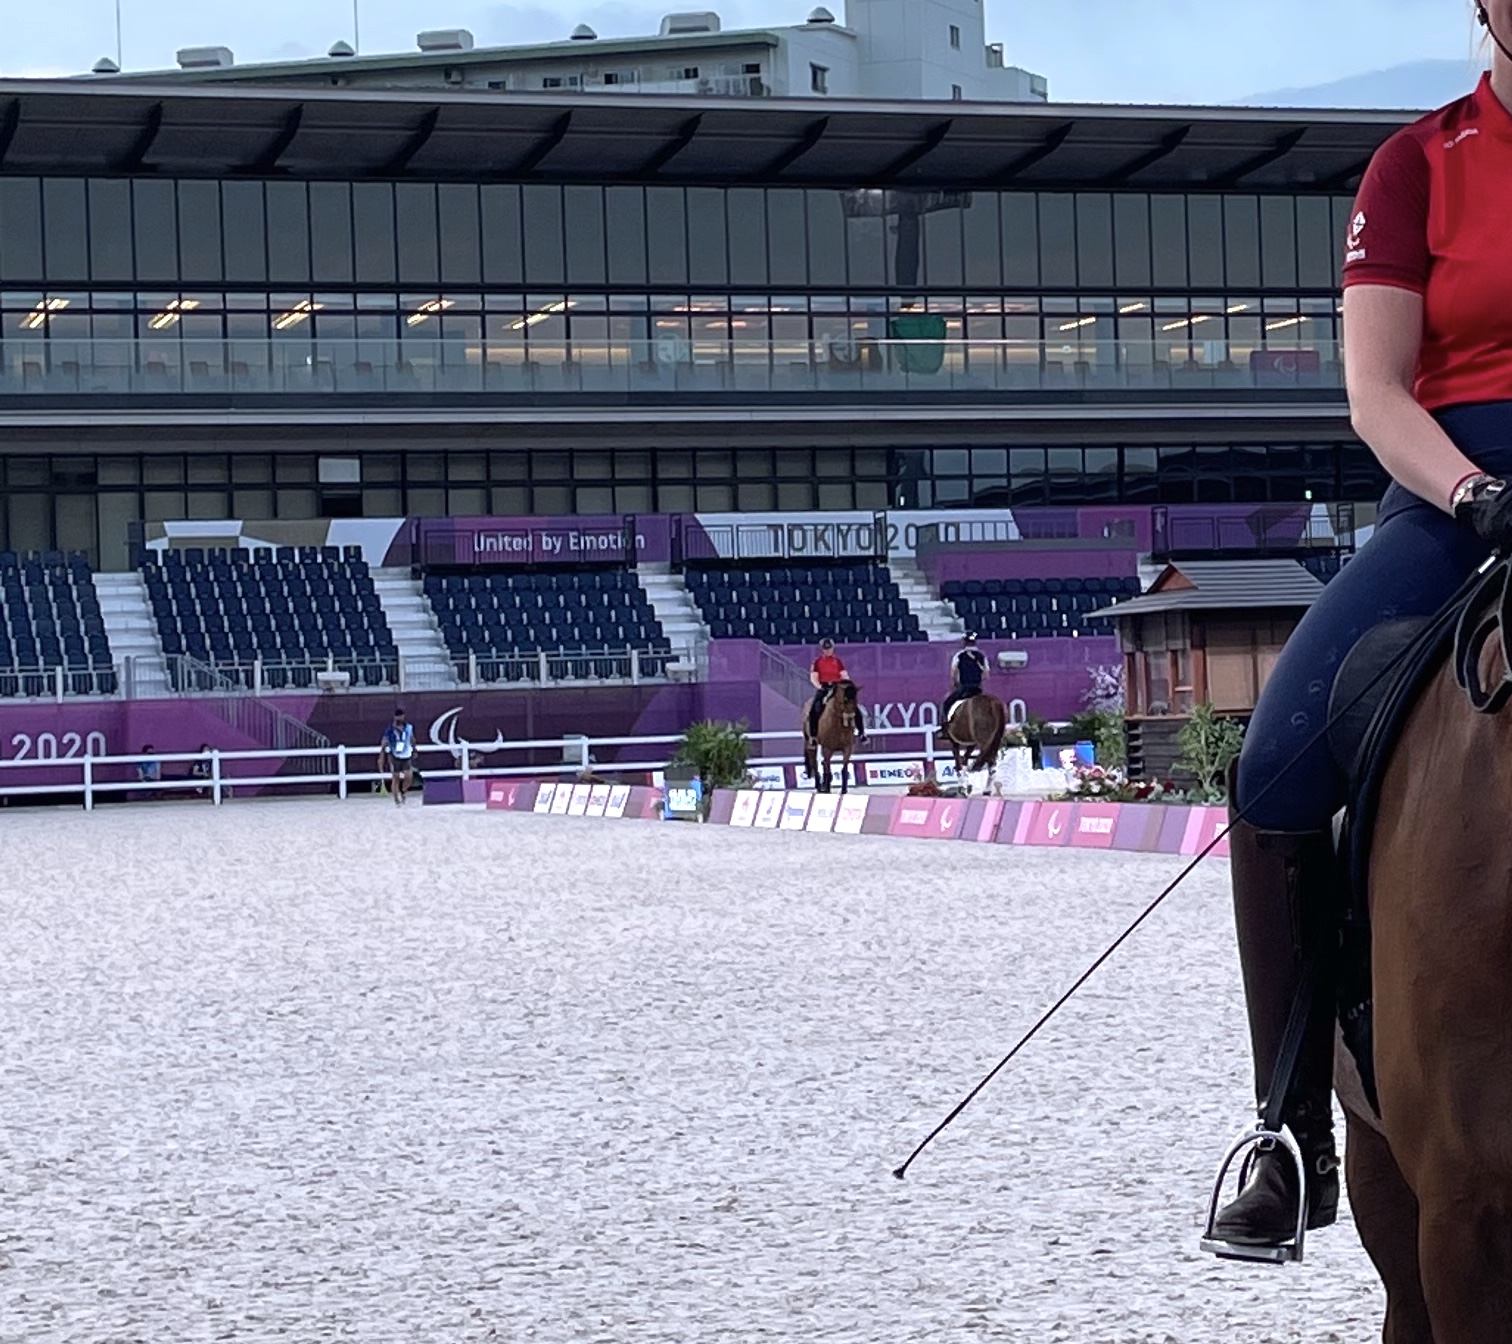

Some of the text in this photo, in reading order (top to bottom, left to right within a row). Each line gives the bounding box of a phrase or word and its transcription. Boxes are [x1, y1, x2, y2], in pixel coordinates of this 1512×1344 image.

[474, 530, 645, 554] United by Emotin
[767, 523, 875, 553] TOKYO
[12, 731, 107, 761] 2020
[880, 768, 921, 779] ENEO
